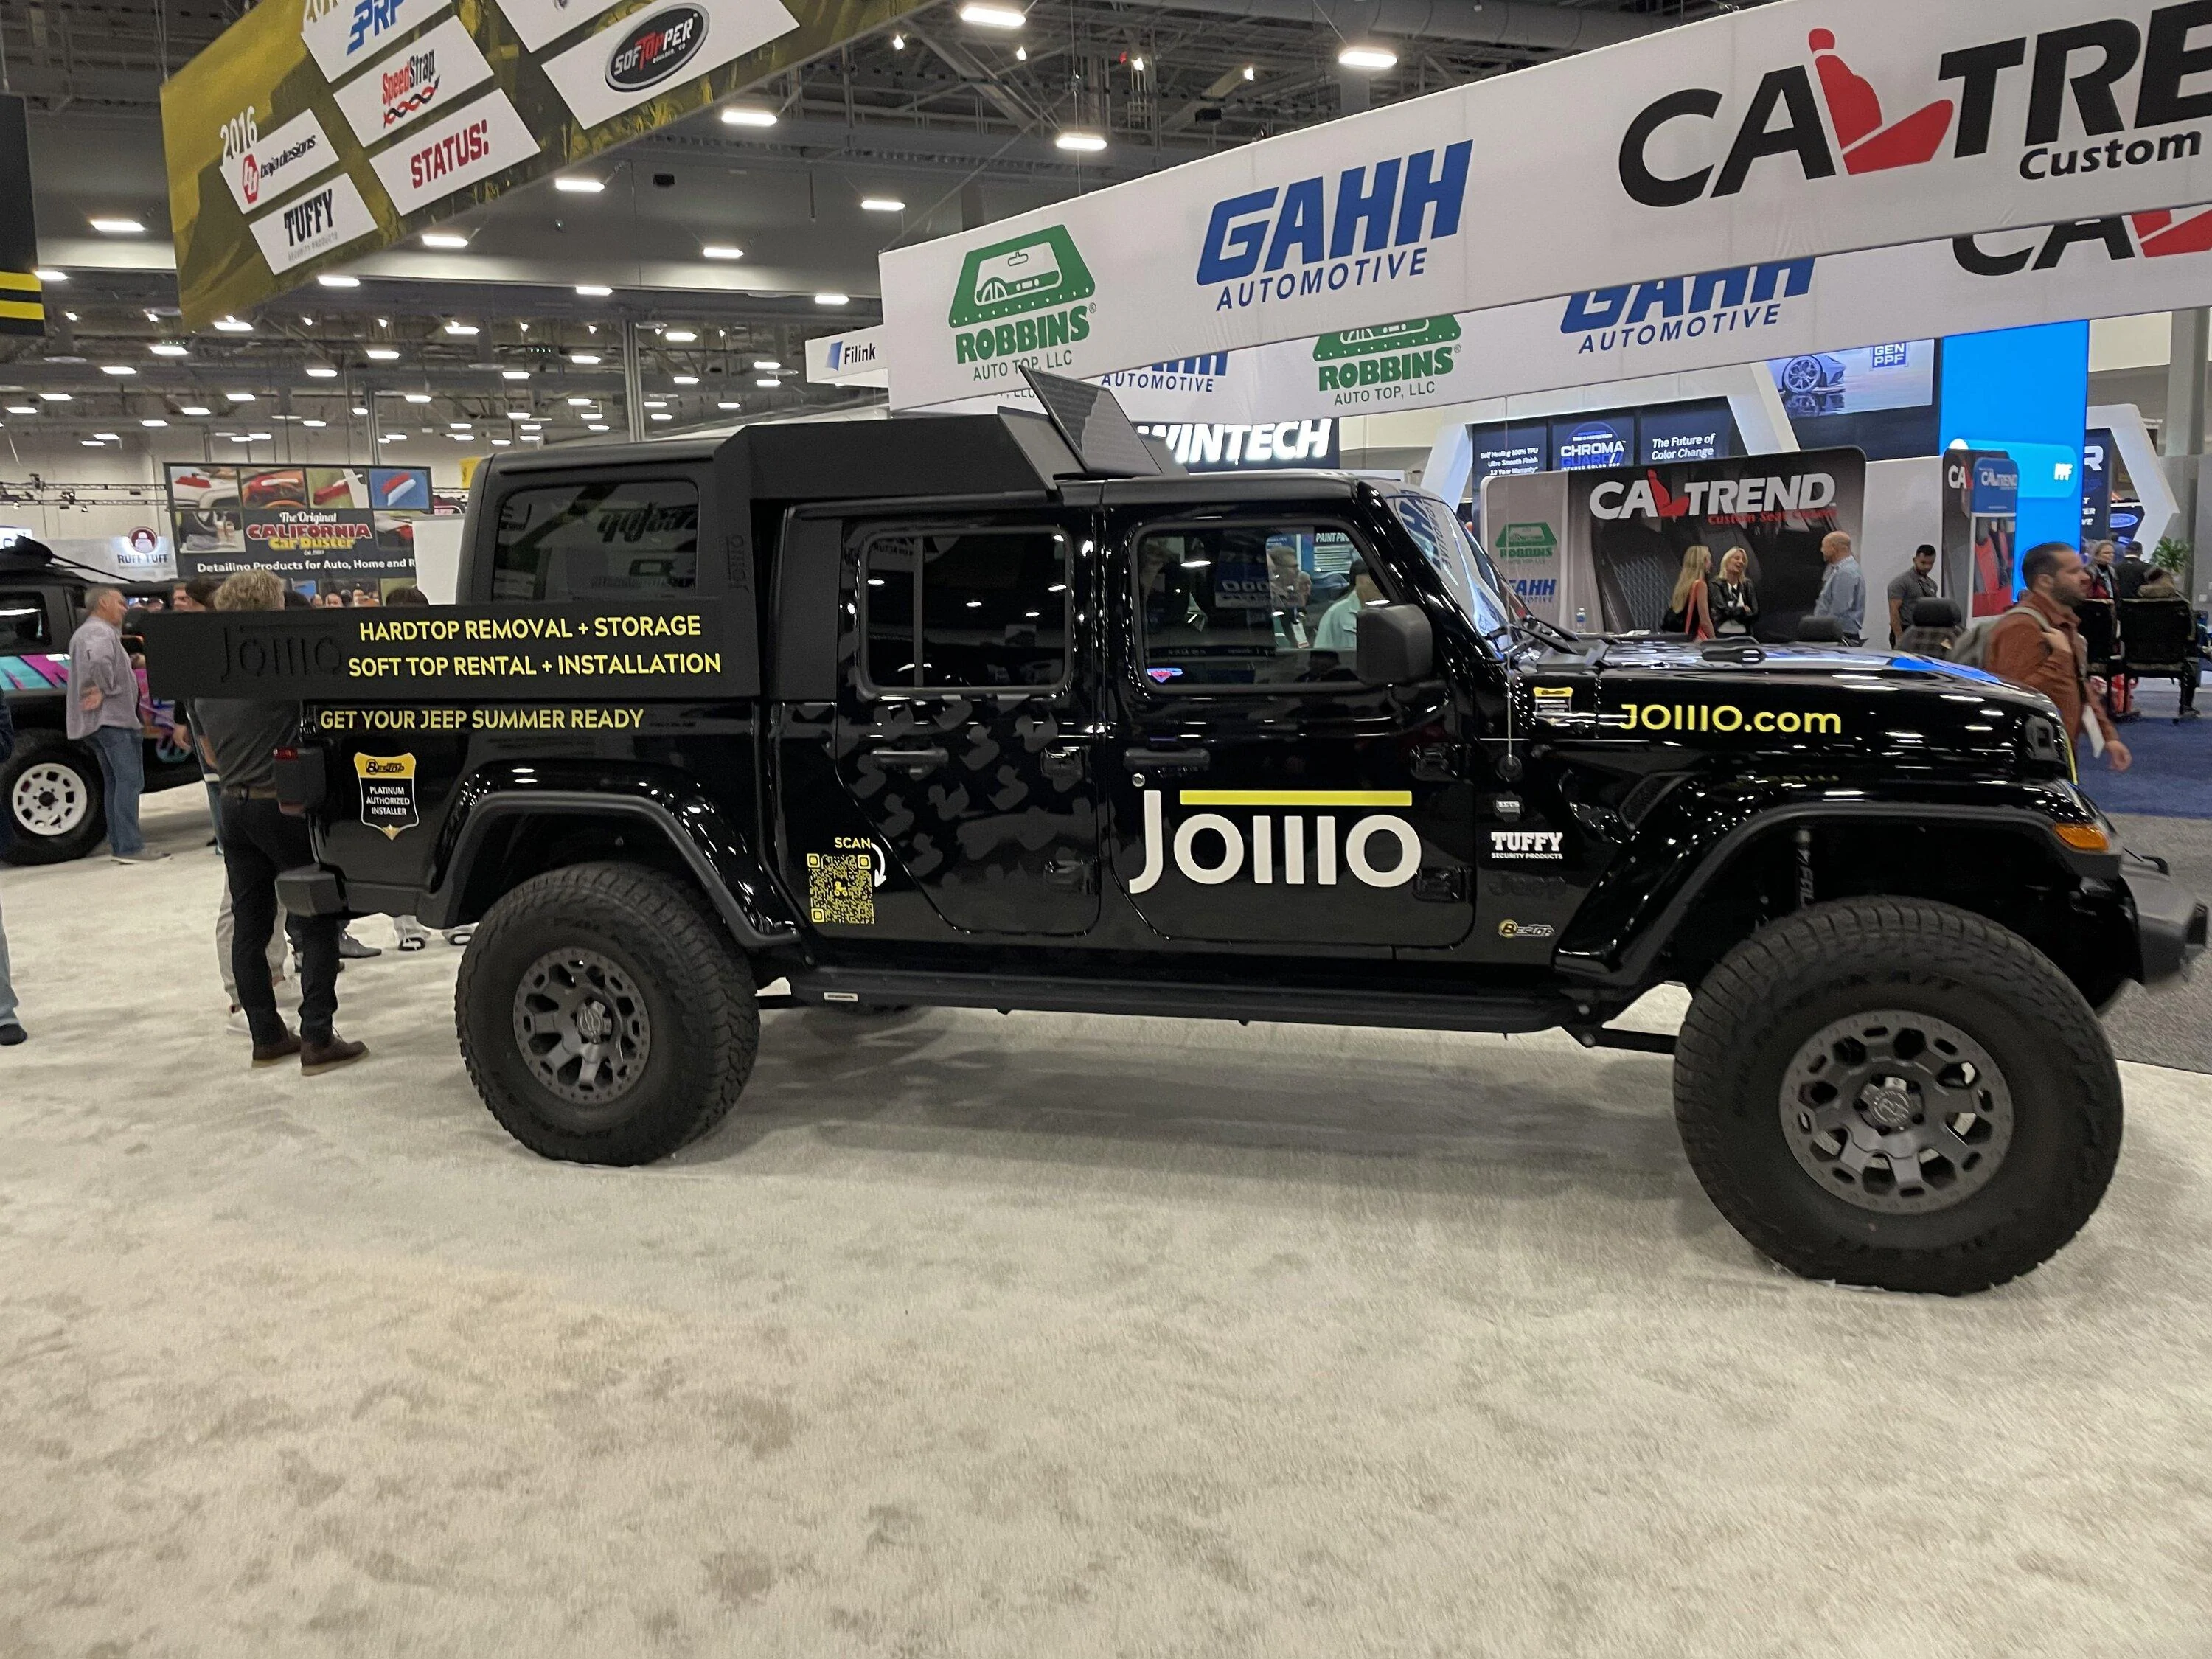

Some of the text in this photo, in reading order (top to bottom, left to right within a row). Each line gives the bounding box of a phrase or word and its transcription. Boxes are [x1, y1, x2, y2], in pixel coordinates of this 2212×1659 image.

[220, 105, 257, 164] 2016
[2019, 130, 2201, 181] Custom
[284, 189, 333, 246] TUFFY
[1197, 139, 1474, 285] GAHH
[1216, 248, 1427, 311] AUTOMOTIVE
[956, 305, 1091, 365] ROBBINS
[1578, 303, 1781, 354] AUTOMOTIVE
[844, 344, 876, 365] Filink
[1874, 343, 1905, 355] GEN
[973, 361, 1009, 381] AUTO
[1047, 350, 1073, 369] LLC
[1318, 347, 1455, 391] ROBBINS
[1874, 354, 1904, 366] PPF
[1102, 372, 1214, 392] AUTOMOTIVE
[1335, 389, 1370, 406] AUTO
[1408, 380, 1436, 395] LLC
[1561, 441, 1624, 456] CHROMA
[1652, 433, 1716, 448] The Future of
[1652, 447, 1714, 460] Color Change
[279, 510, 337, 524] The Original
[246, 524, 372, 540] CALIFORNIA
[268, 535, 355, 551] Car Duster
[253, 560, 303, 571] Products
[305, 560, 321, 569] for
[324, 559, 352, 571] Auto,
[353, 558, 384, 569] Home
[387, 558, 406, 568] and
[359, 615, 701, 641] HARDTOP REMOVAL + STORAGE
[349, 653, 722, 678] SOFT TOP RENTAL + INSTALLATION
[320, 709, 644, 730] GET YOUR JEEP SUMMER READY
[366, 796, 410, 805] AUTHORIZED
[369, 786, 405, 795] PLATINUM
[371, 807, 407, 815] INSTALLER
[835, 837, 871, 849] SCAN
[1490, 832, 1563, 852] TUFFY
